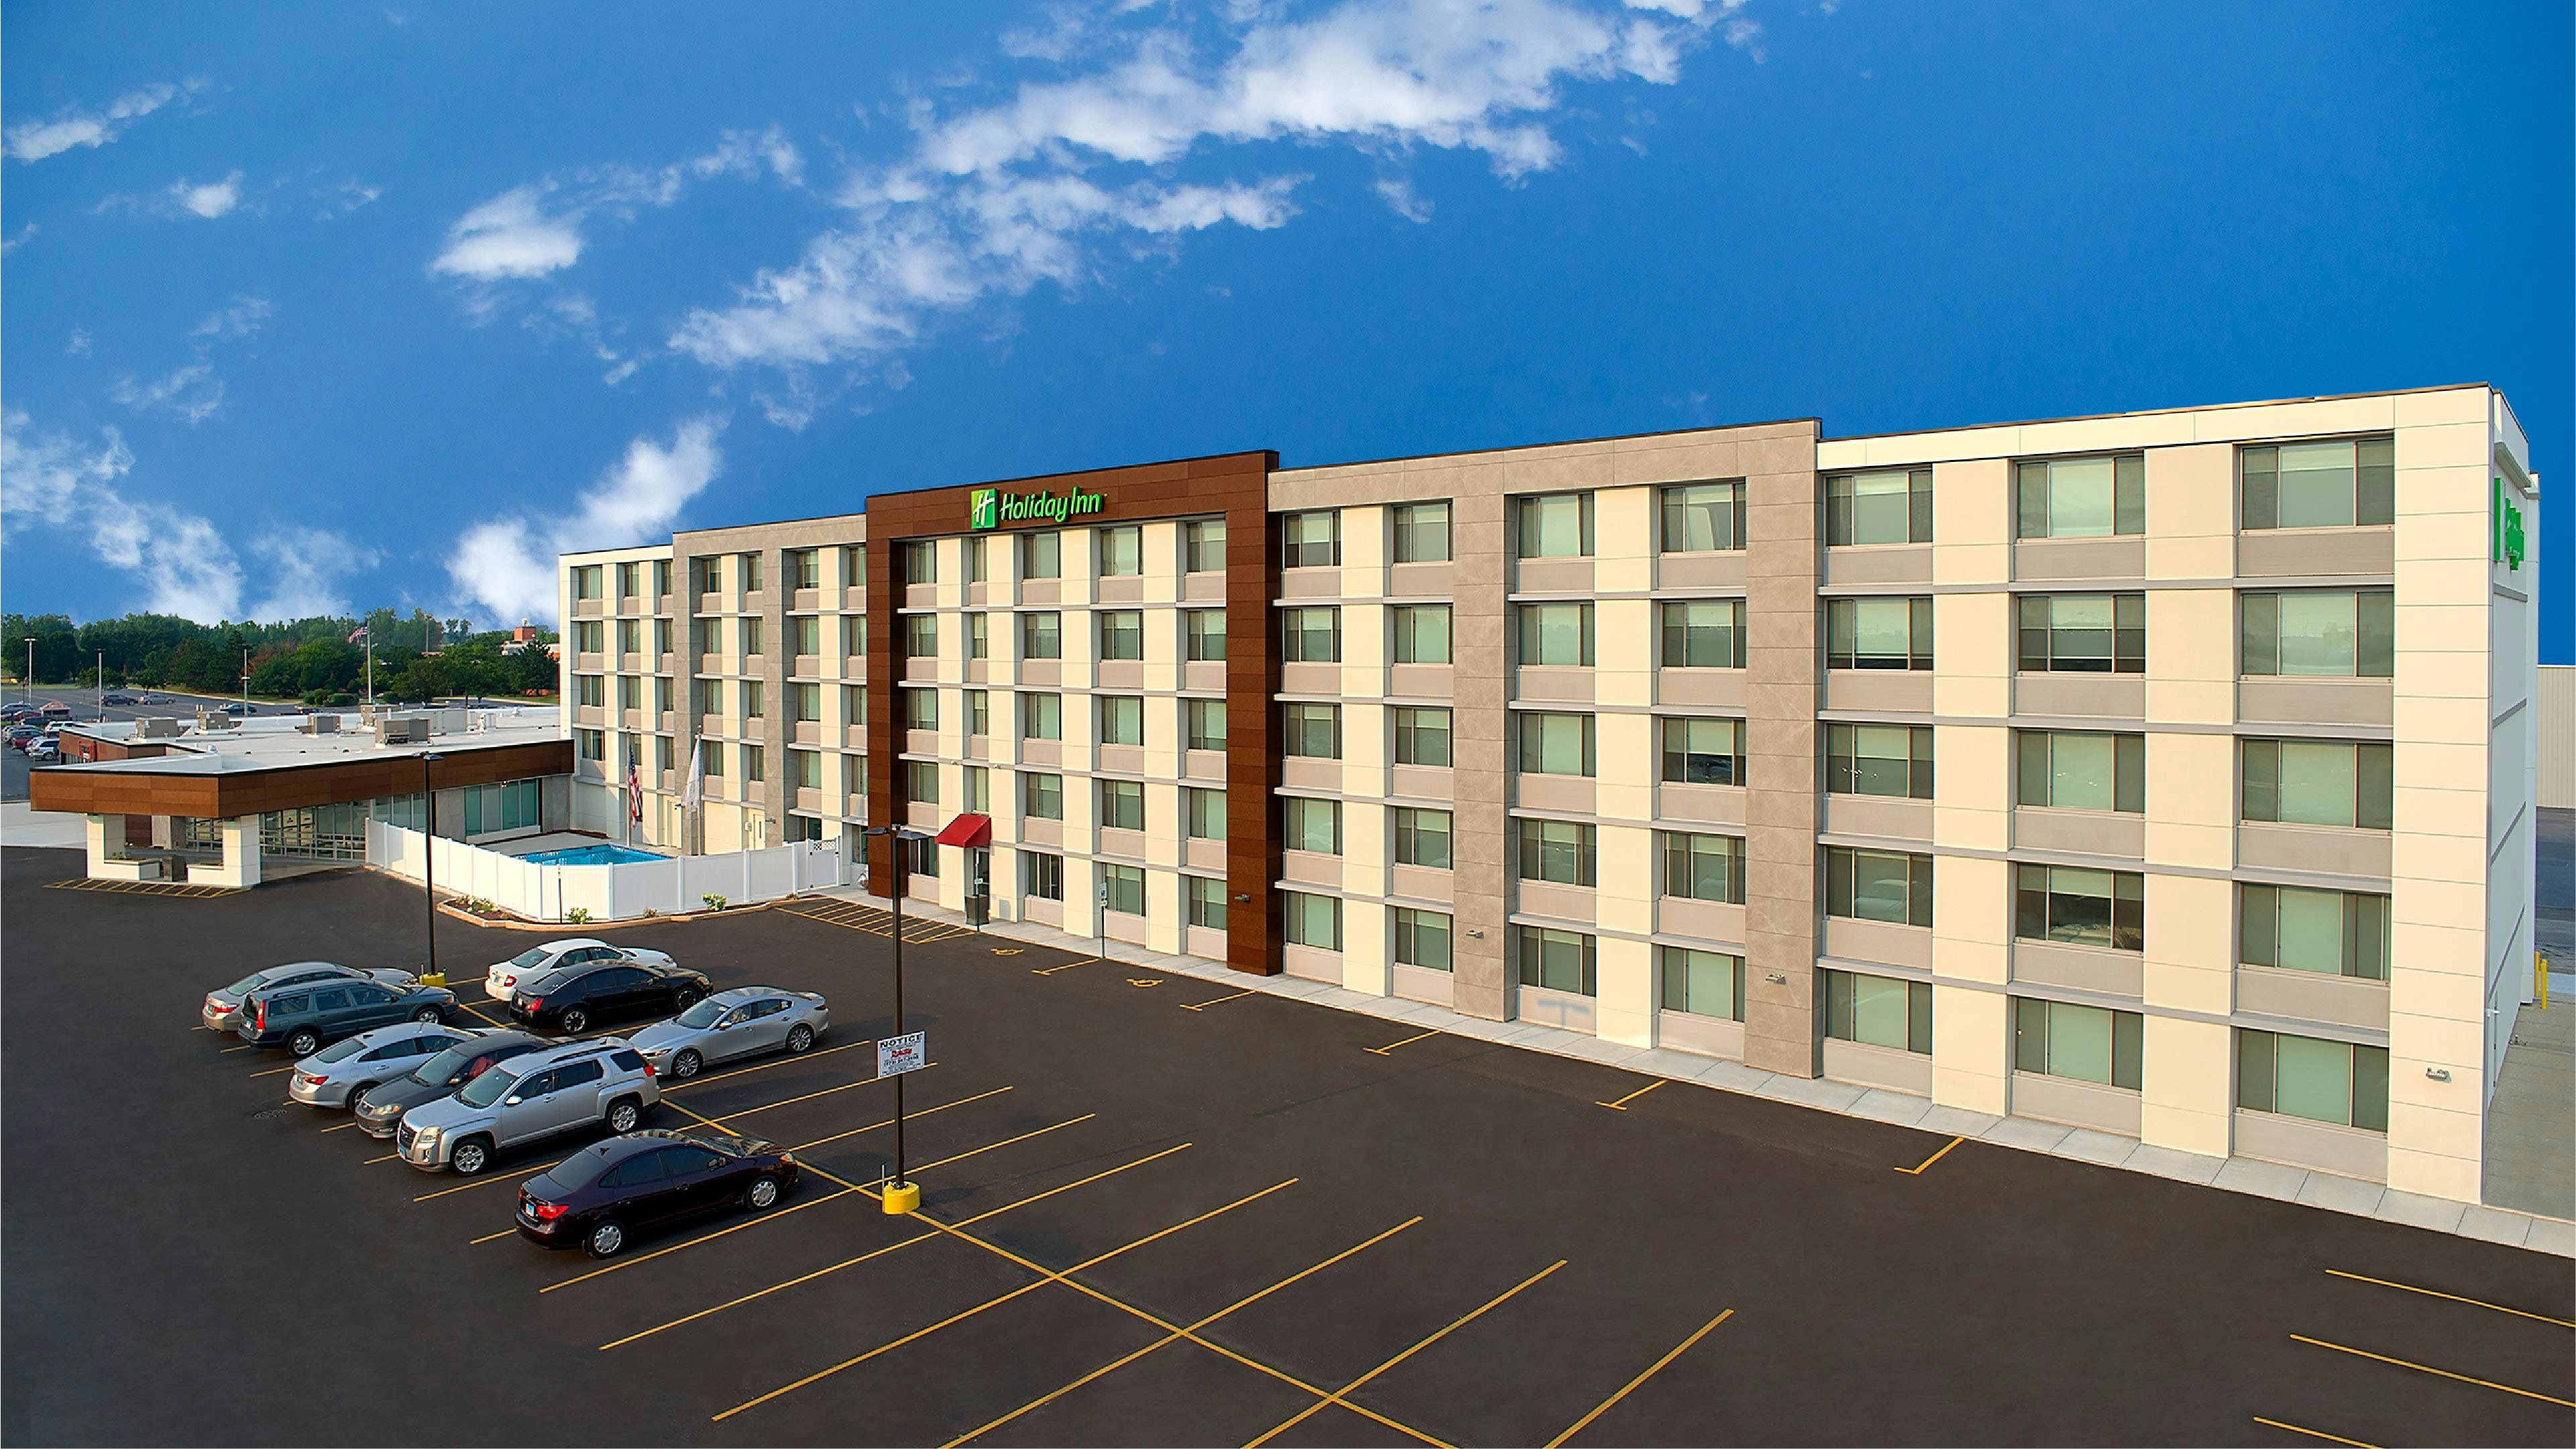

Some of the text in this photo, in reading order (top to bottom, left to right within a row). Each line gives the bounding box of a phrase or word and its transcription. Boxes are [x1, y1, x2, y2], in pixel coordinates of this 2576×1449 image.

[1000, 485, 1101, 522] Holiday Inn
[880, 1033, 923, 1047] NOTICE
